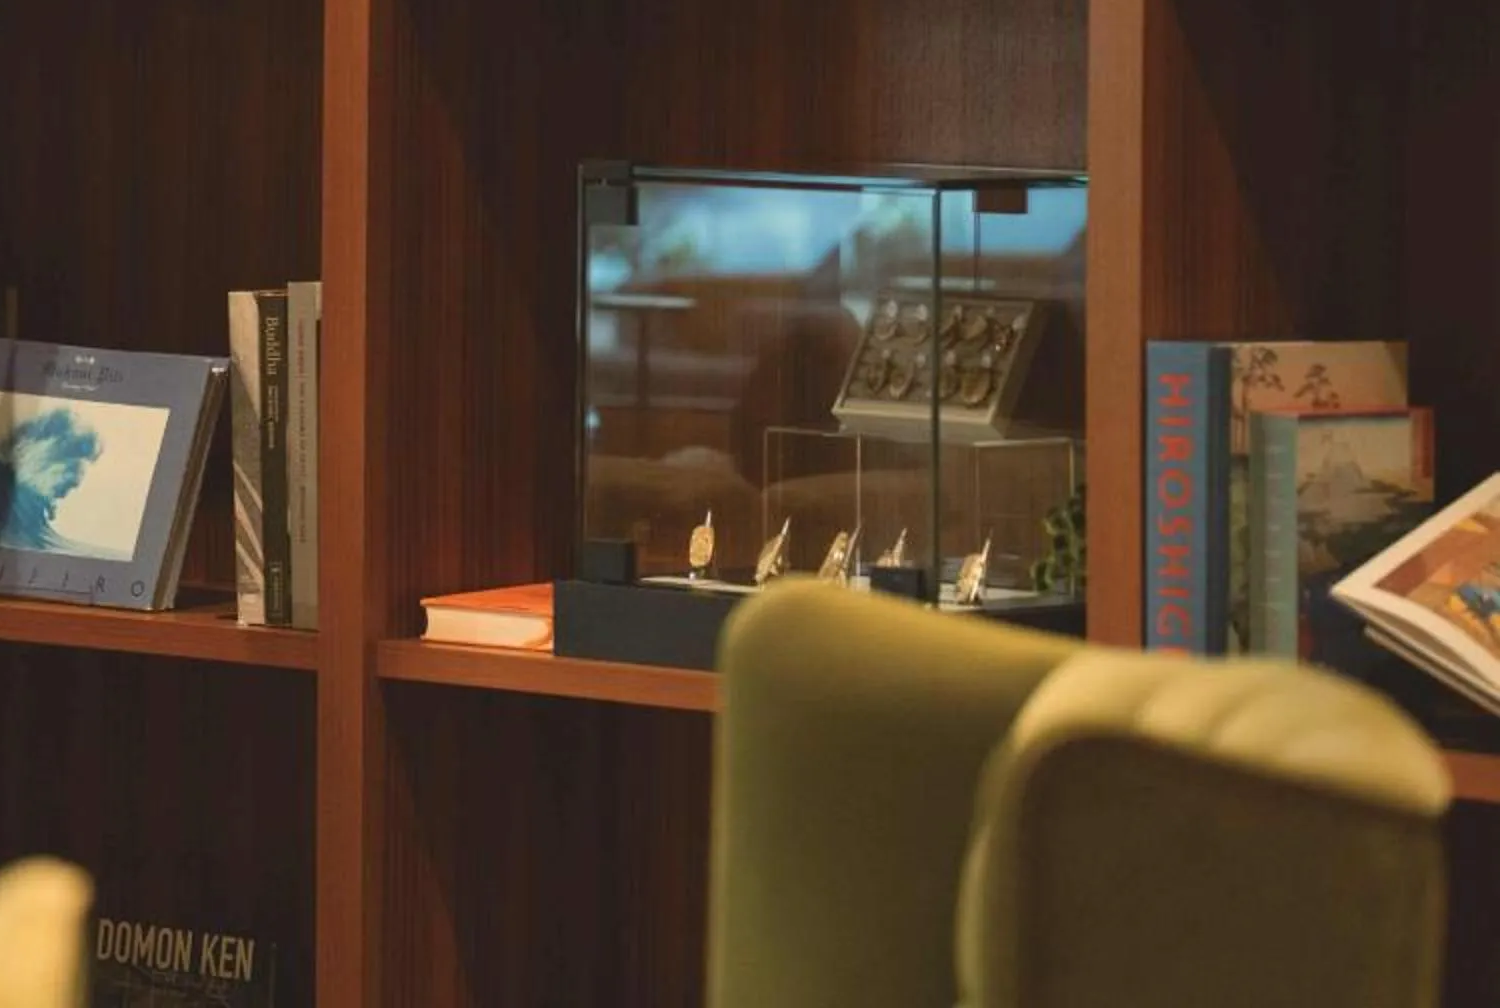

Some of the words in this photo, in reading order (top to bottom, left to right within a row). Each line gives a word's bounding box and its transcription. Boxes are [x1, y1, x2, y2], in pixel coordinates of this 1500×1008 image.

[266, 316, 283, 375] Buddha
[1155, 372, 1194, 654] HIROSHIG
[96, 917, 193, 973] DOMON
[198, 933, 254, 982] KEN
